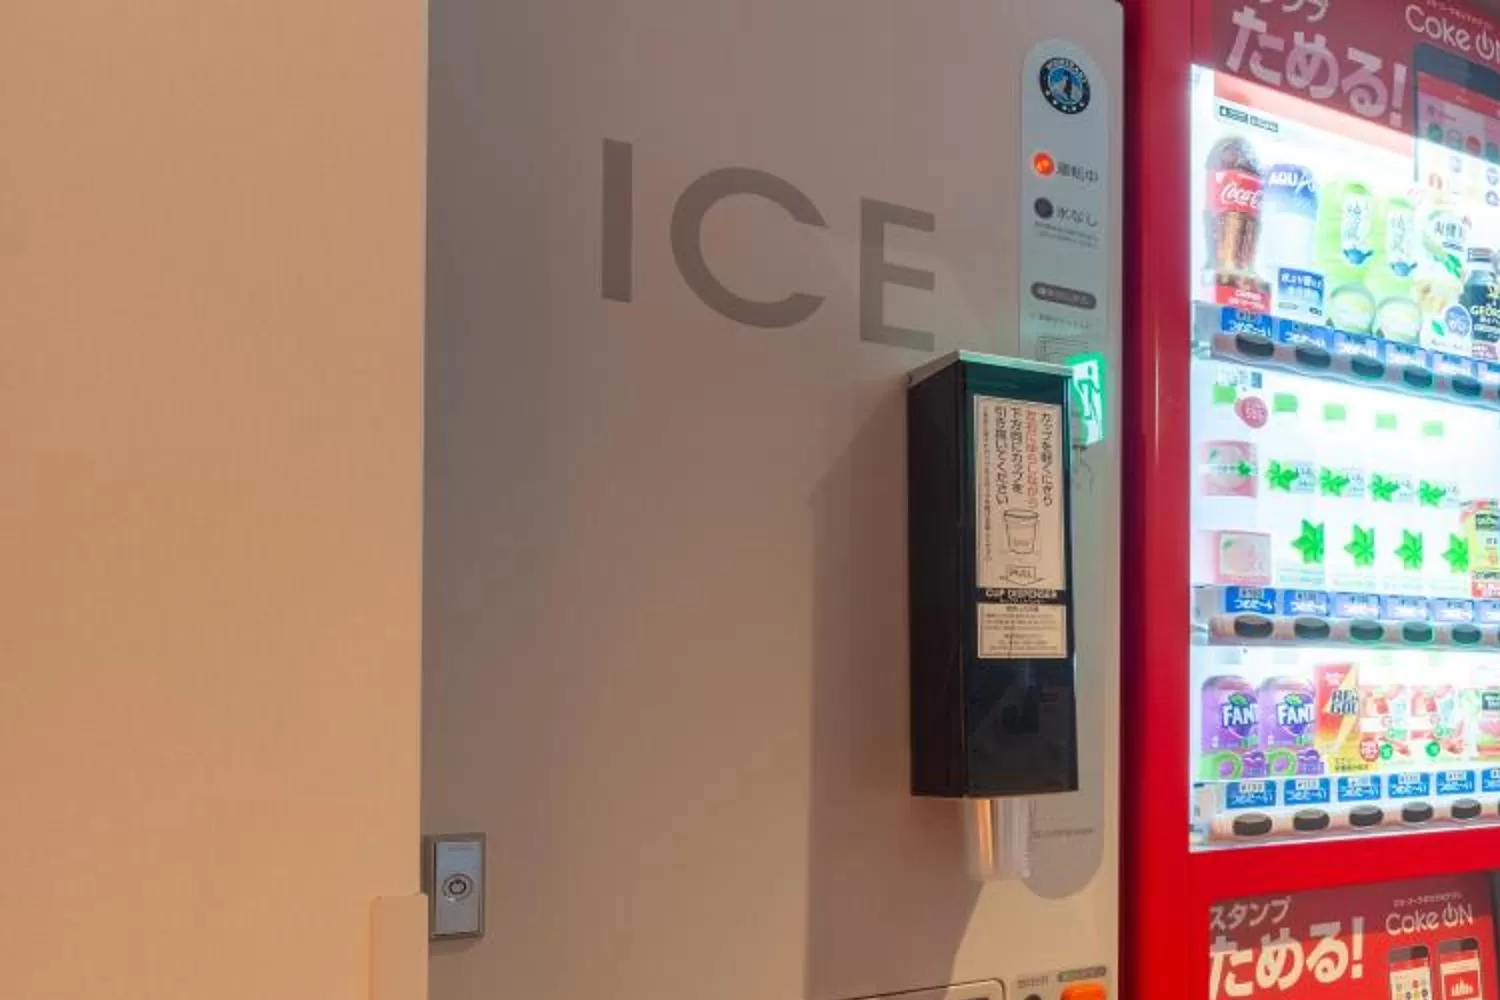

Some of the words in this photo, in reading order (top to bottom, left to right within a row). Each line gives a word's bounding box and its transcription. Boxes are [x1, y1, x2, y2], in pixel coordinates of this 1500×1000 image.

[1405, 3, 1472, 51] Coke
[1225, 5, 1407, 128] ためる!
[600, 137, 936, 352] ICE
[1210, 896, 1292, 930] スタンプ
[1385, 908, 1440, 937] Coke
[1441, 902, 1474, 928] ON
